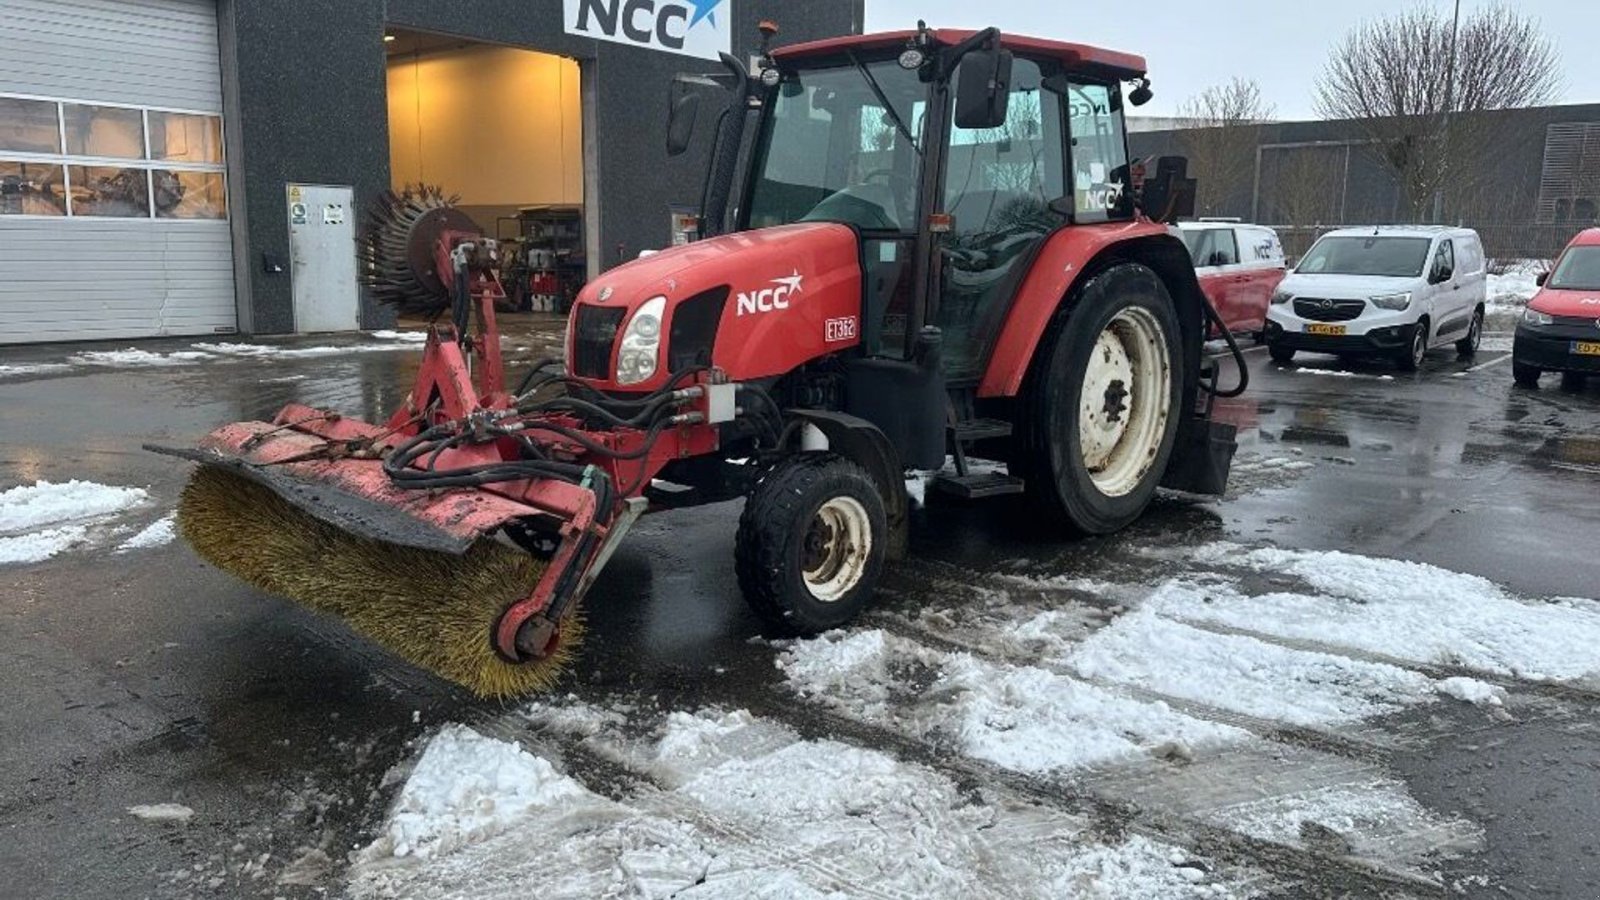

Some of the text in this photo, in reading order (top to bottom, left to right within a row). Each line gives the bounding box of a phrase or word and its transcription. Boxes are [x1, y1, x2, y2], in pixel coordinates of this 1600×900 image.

[575, 0, 687, 49] NCC
[1085, 190, 1115, 209] NCC
[737, 285, 789, 316] NCC
[827, 319, 855, 339] ET362
